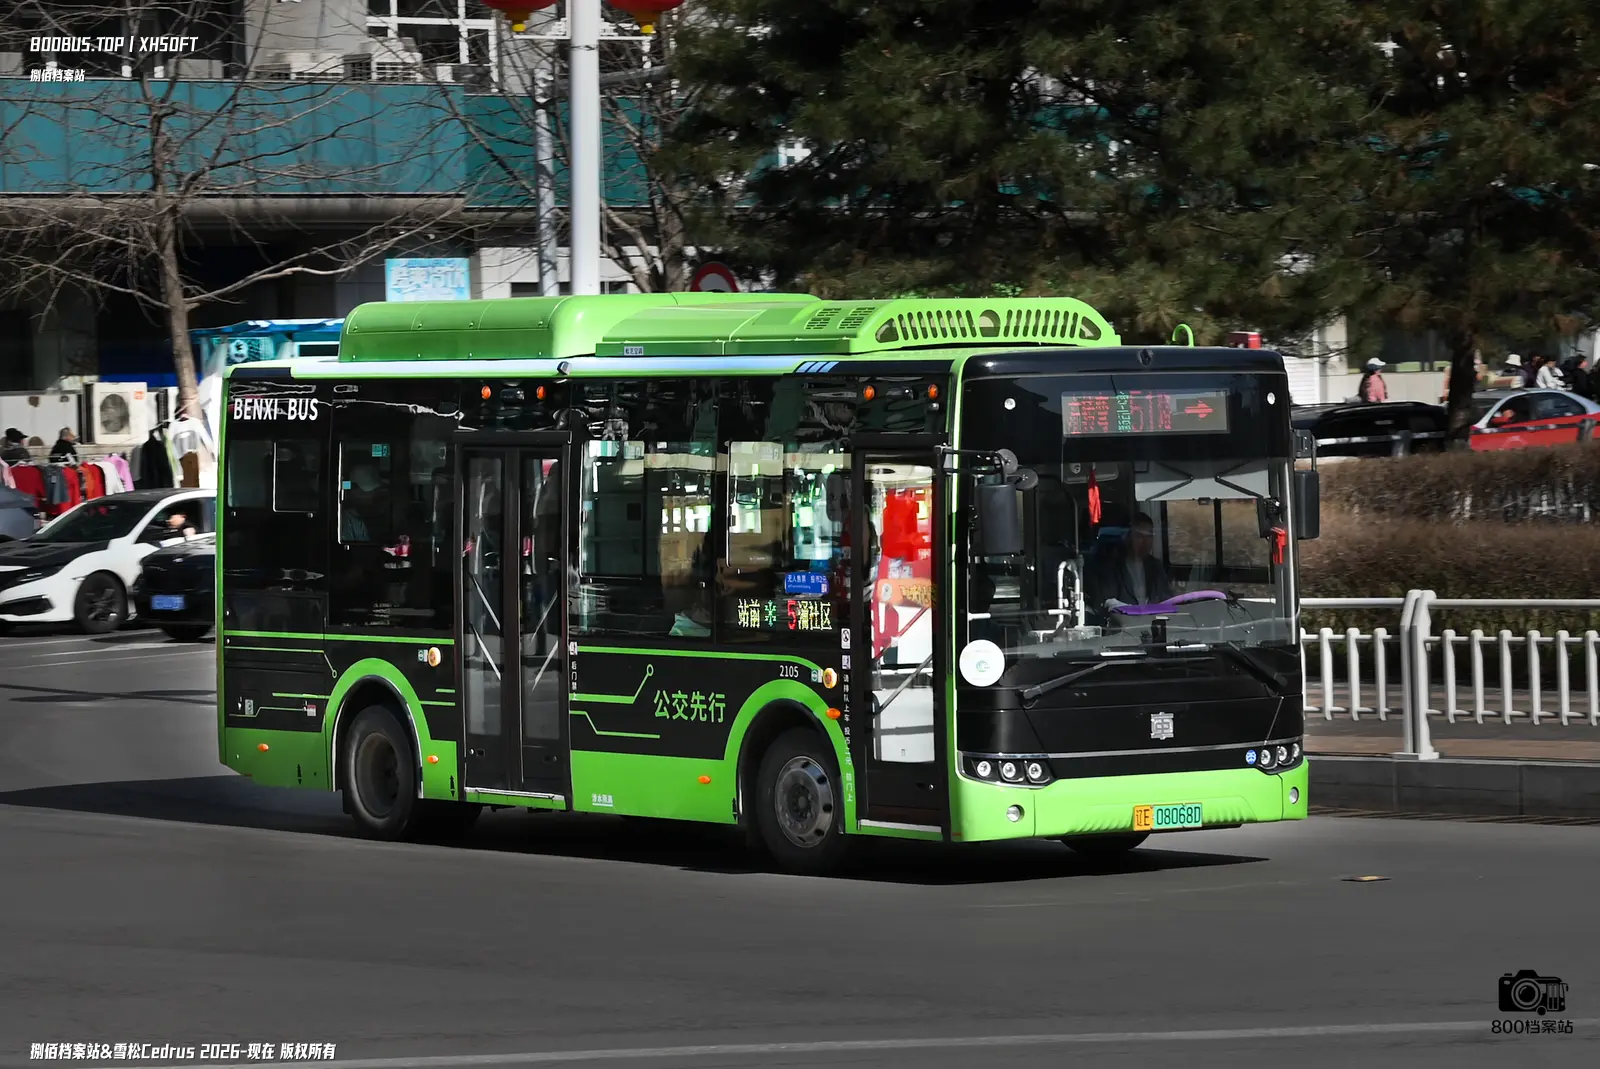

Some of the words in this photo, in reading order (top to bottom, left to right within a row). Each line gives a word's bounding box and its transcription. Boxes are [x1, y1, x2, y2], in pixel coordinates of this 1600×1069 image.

[233, 398, 278, 420] BENXI
[287, 398, 319, 421] BUS
[779, 665, 799, 678] 2105
[653, 689, 726, 723] 公交先行
[1156, 806, 1201, 825] 08068D
